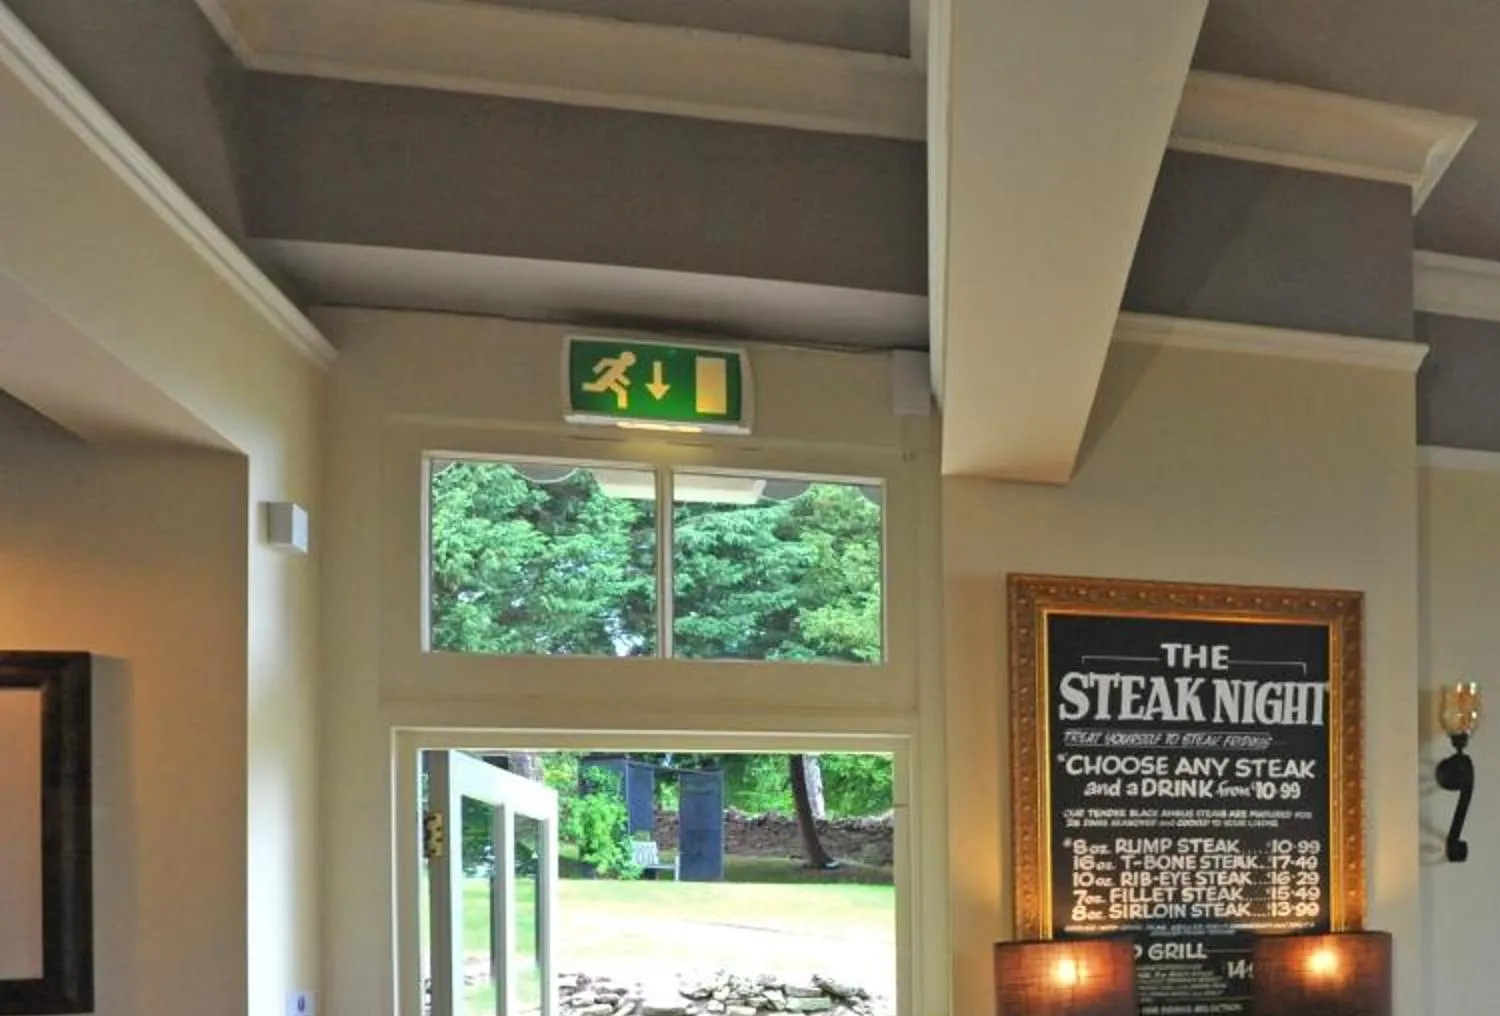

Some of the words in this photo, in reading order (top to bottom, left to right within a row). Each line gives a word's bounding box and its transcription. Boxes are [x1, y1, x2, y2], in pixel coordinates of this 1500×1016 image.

[1161, 643, 1230, 670] THE
[1059, 671, 1206, 721] STEAK
[1212, 679, 1329, 726] NIGHT
[1065, 755, 1168, 776] CHOOSE
[1174, 757, 1230, 777] ANY
[1235, 758, 1316, 779] STEAK
[1083, 777, 1121, 797] and
[1125, 782, 1139, 797] a
[1141, 777, 1214, 798] DRINK
[1216, 780, 1250, 797] from
[1115, 838, 1173, 854] RUMP
[1177, 838, 1241, 854] STEAK
[1120, 854, 1197, 871] T-BONE
[1200, 855, 1258, 870] STEAK
[1120, 871, 1193, 887] RIB-EYE
[1195, 871, 1252, 886] STEAK
[1109, 888, 1178, 903] FILLET
[1180, 887, 1244, 903] STEAK
[1108, 903, 1187, 920] SIRLOIN
[1191, 902, 1251, 919] STEAK
[1148, 943, 1208, 961] GRILL
